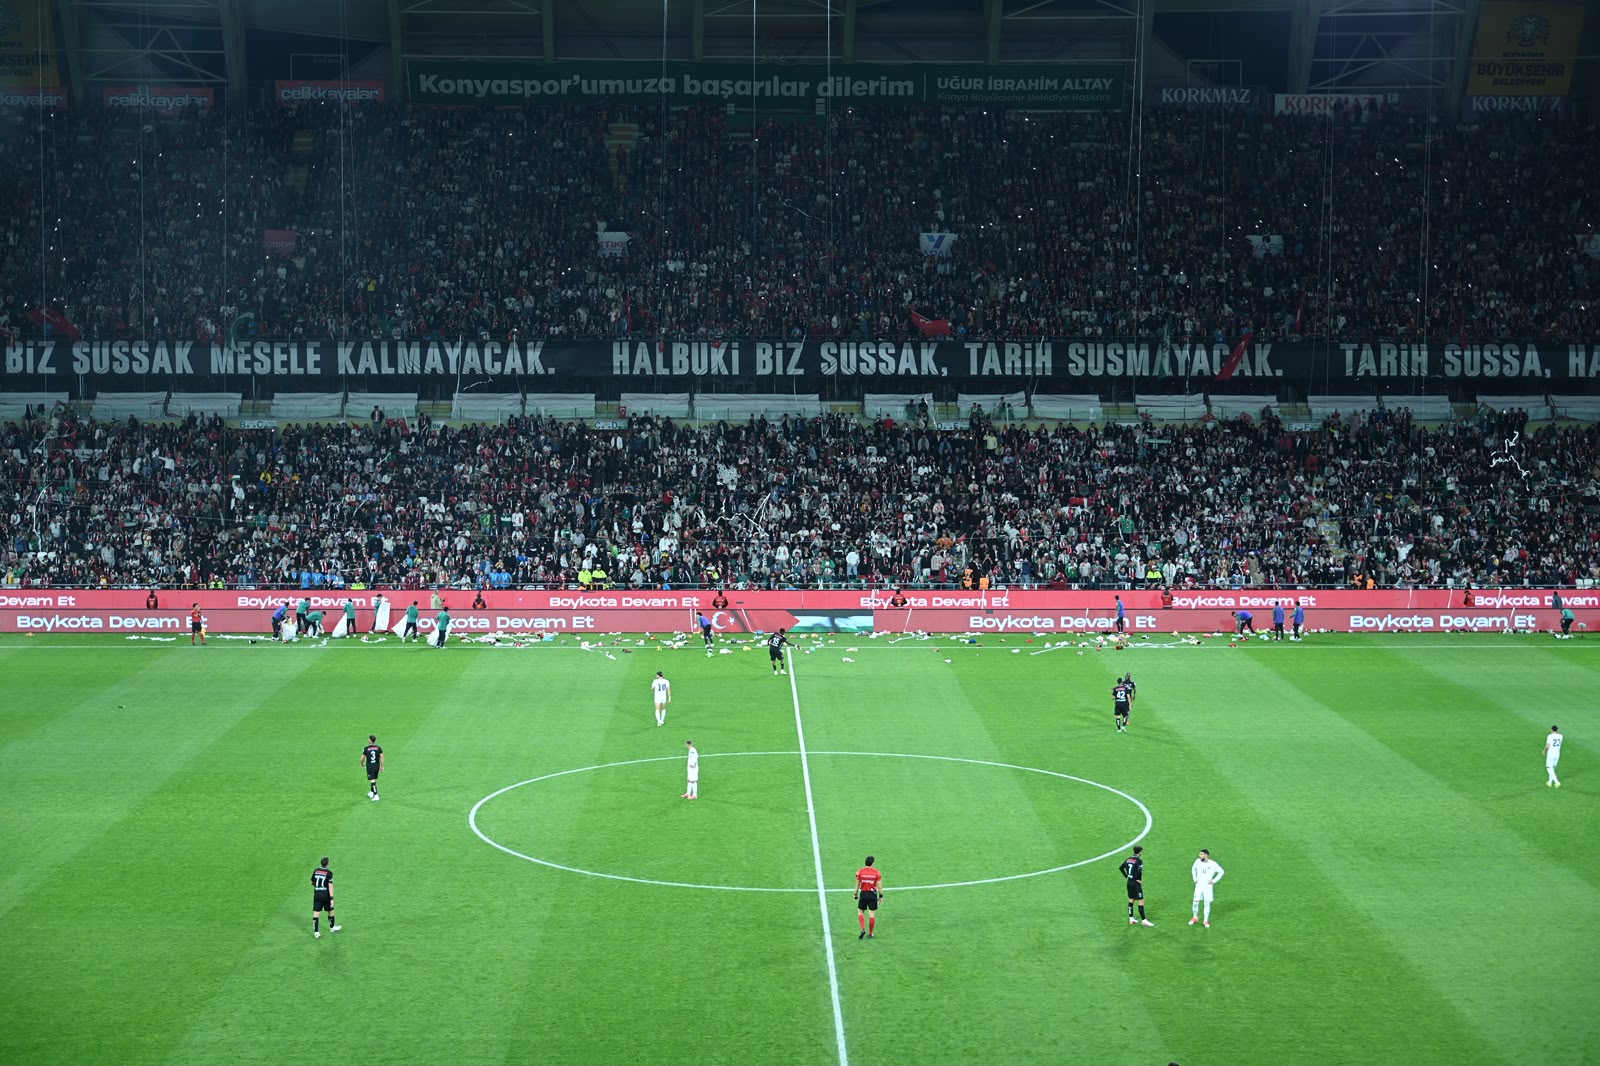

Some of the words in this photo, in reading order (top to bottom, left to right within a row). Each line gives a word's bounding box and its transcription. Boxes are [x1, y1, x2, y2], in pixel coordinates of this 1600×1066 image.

[683, 74, 810, 99] başarılar
[816, 75, 914, 97] dilerim
[936, 75, 984, 91] UĞUR
[987, 75, 1058, 91] İBRAHİM
[1061, 77, 1114, 91] ALTAY
[1161, 87, 1251, 104] KORKMAZ
[72, 341, 194, 375] SUSSAK
[210, 341, 321, 375] MESELE
[337, 341, 555, 375] KALMAYACAK.
[820, 342, 948, 377] SUSSAK,
[1444, 344, 1551, 378] SUSSA,
[0, 595, 52, 606] Devam
[57, 596, 75, 606] Et
[370, 596, 391, 607] E
[549, 596, 618, 609] Boykota
[621, 596, 678, 607] Devam
[681, 596, 700, 607] Et
[932, 597, 988, 607] Devam
[991, 597, 1009, 607] Et
[1172, 595, 1236, 609] Boykota
[1239, 596, 1296, 607] Devam
[1299, 596, 1316, 606] Et
[1475, 595, 1540, 608] Boykota
[1545, 596, 1599, 606] Dvam
[16, 614, 103, 631] Boykota
[109, 615, 180, 628] Devam
[416, 614, 491, 630] okota
[496, 615, 567, 628] Devam
[572, 615, 595, 628] Et
[969, 614, 1055, 631] Boykota
[1135, 615, 1157, 628] Et
[1349, 614, 1434, 631] Boykota
[1439, 614, 1509, 628] Devam
[1514, 614, 1537, 628] Et
[657, 683, 667, 691] 10
[1116, 690, 1126, 699] 42
[370, 750, 376, 761] 3
[314, 874, 327, 888] 77
